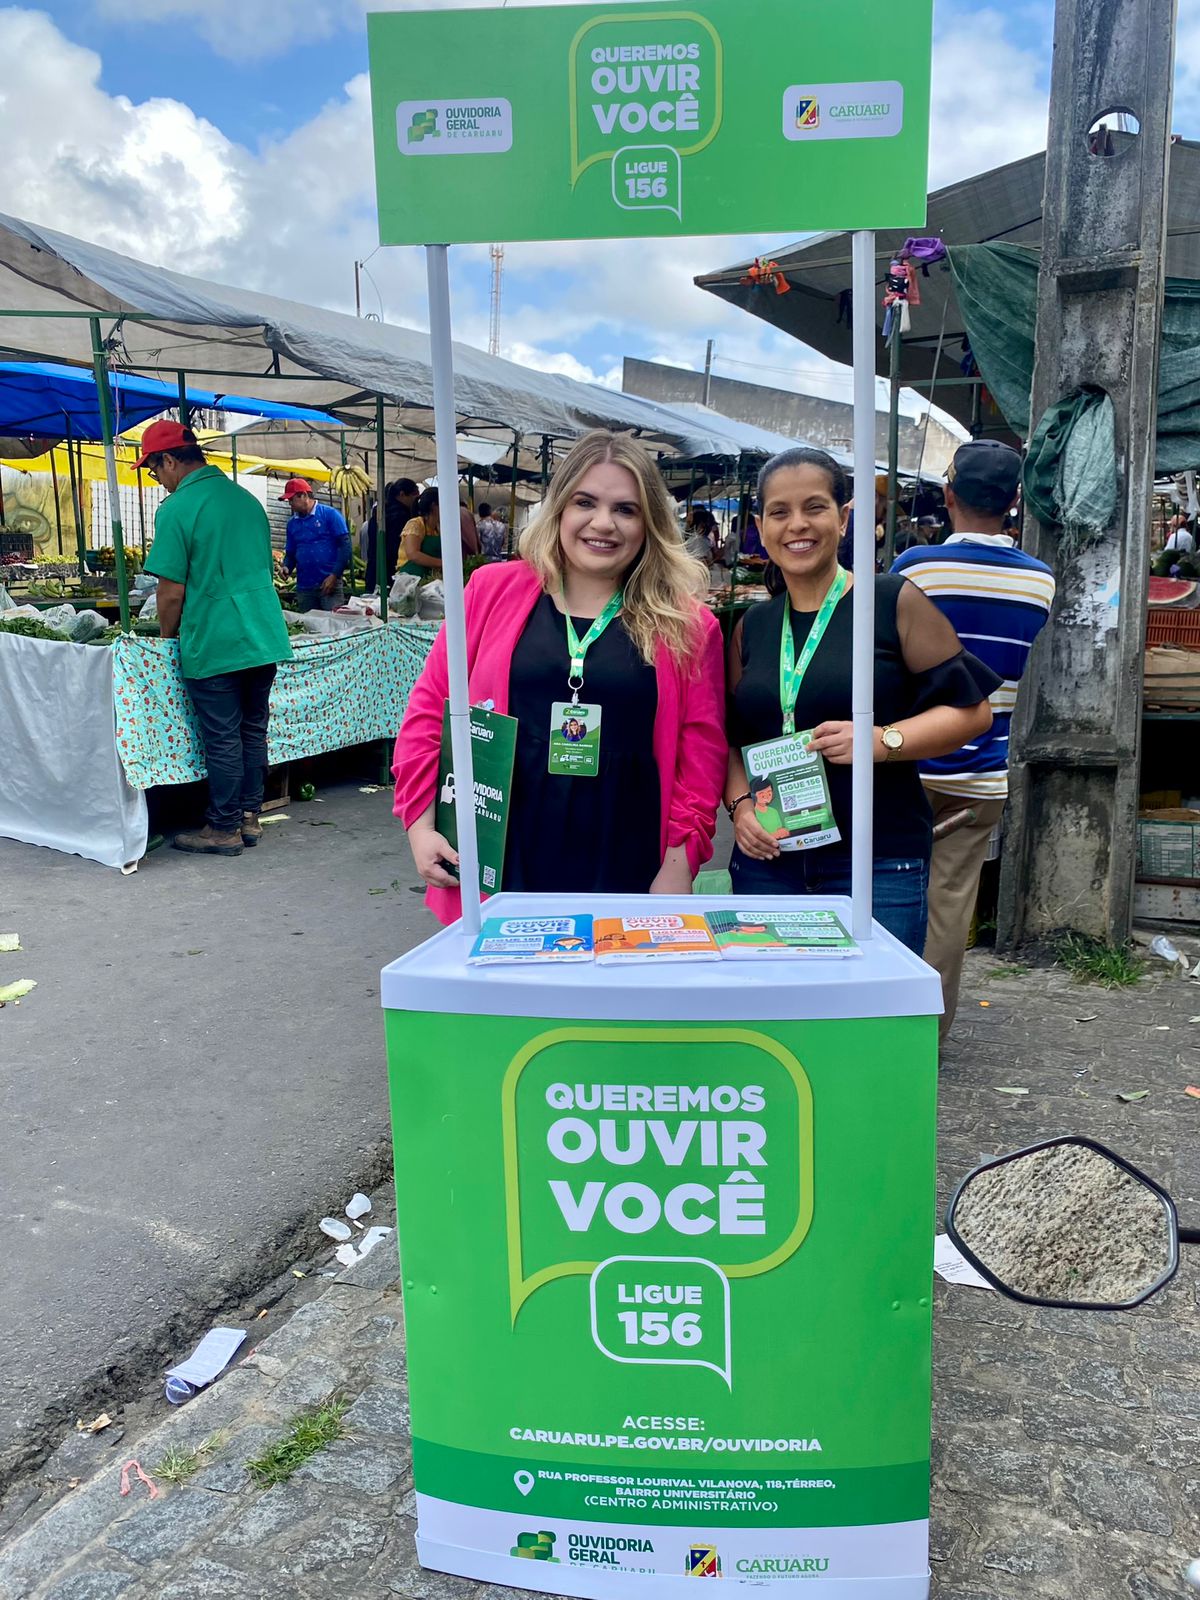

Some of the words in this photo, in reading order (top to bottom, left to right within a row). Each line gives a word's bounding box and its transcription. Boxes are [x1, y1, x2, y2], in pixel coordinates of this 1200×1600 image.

[591, 43, 700, 63] QUEREMOS
[591, 64, 700, 95] OUVIR
[445, 106, 501, 119] OUVIDORIA
[592, 94, 700, 135] VOCÊ
[829, 104, 890, 117] CARUARU
[446, 119, 480, 130] GERAL
[462, 130, 503, 138] CARUARU
[625, 161, 667, 175] LIGUE
[625, 178, 667, 199] 156
[470, 722, 493, 740] aruaru
[752, 741, 802, 761] QUEREMOS
[754, 756, 784, 771] OUVIR
[473, 781, 503, 803] VIDORIA
[779, 780, 805, 792] LIGUE
[806, 777, 821, 787] 156
[474, 793, 487, 809] RAL
[803, 833, 832, 844] Caruaru
[545, 1082, 766, 1112] QUEREMOS
[546, 1117, 768, 1166] OUVIR
[548, 1170, 766, 1235] VOCÊ
[618, 1284, 702, 1305] LIGUE
[617, 1311, 702, 1346] 156
[622, 1415, 705, 1431] ACESSE:
[509, 1427, 822, 1453] CARUARU.PE.GOV.BR/OUVIDORIA
[538, 1470, 562, 1481] RUA
[565, 1472, 634, 1486] PROFESSOR
[637, 1476, 696, 1488] LOURIVAL
[698, 1479, 763, 1490] VILANOVA,
[615, 1487, 661, 1498] BAIRRO
[663, 1488, 756, 1500] UNIVERSITÁRIO
[584, 1495, 648, 1510] (CENTRO
[651, 1497, 779, 1513] ADMINISTRATIVO)
[568, 1533, 654, 1553] OUVIDORIA
[569, 1548, 620, 1564] GERAL
[736, 1558, 829, 1573] CARUARU
